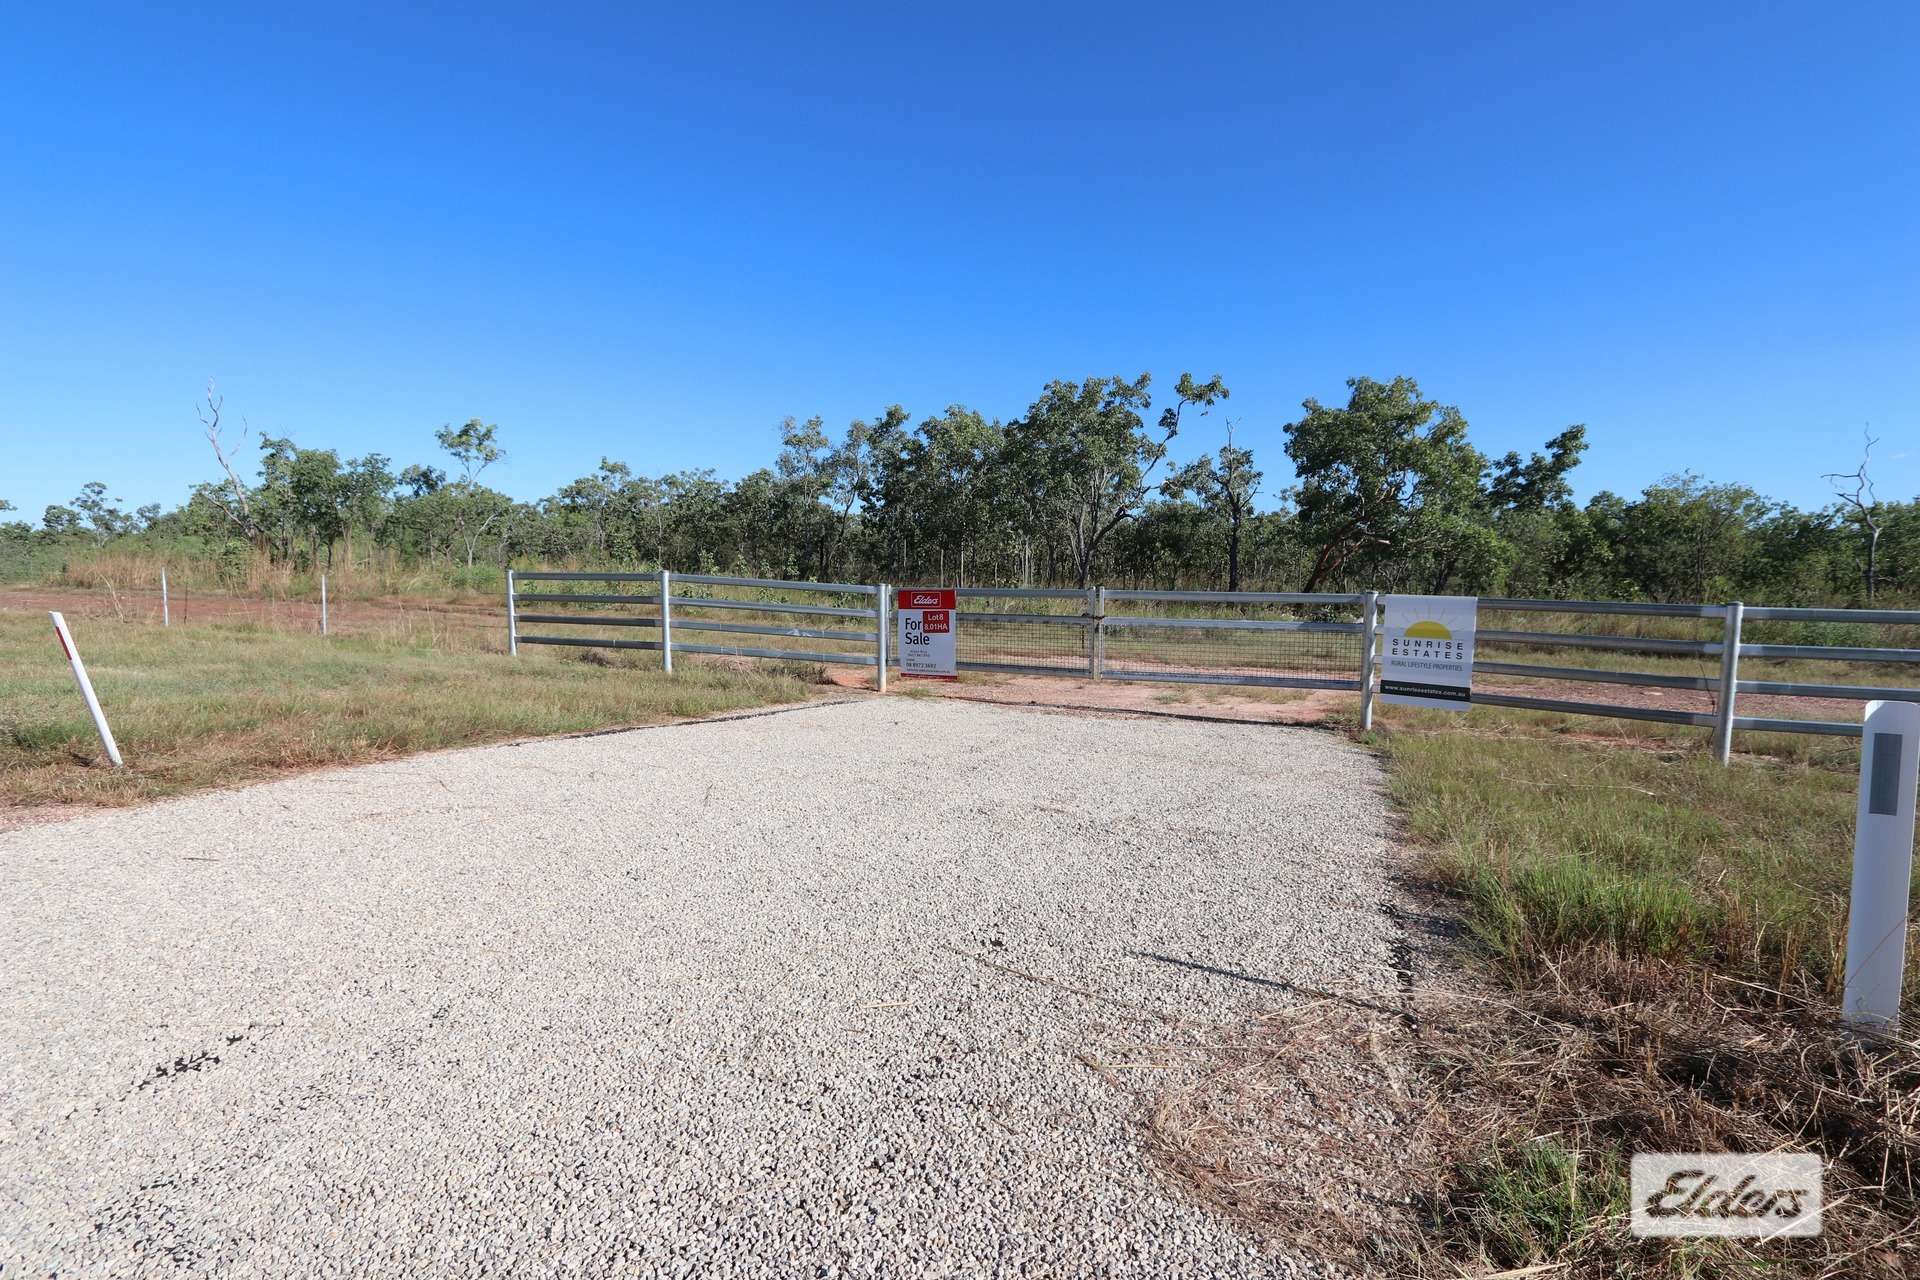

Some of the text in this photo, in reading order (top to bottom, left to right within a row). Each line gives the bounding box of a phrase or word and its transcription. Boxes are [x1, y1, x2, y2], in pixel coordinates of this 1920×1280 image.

[913, 594, 939, 605] Elders
[905, 617, 922, 630] For
[905, 632, 930, 645] Sale
[1392, 638, 1464, 650] SUNRISE
[1391, 648, 1463, 660] ESTATES
[1408, 661, 1432, 670] LIFESTYLE
[1432, 663, 1464, 672] PROPERTIES
